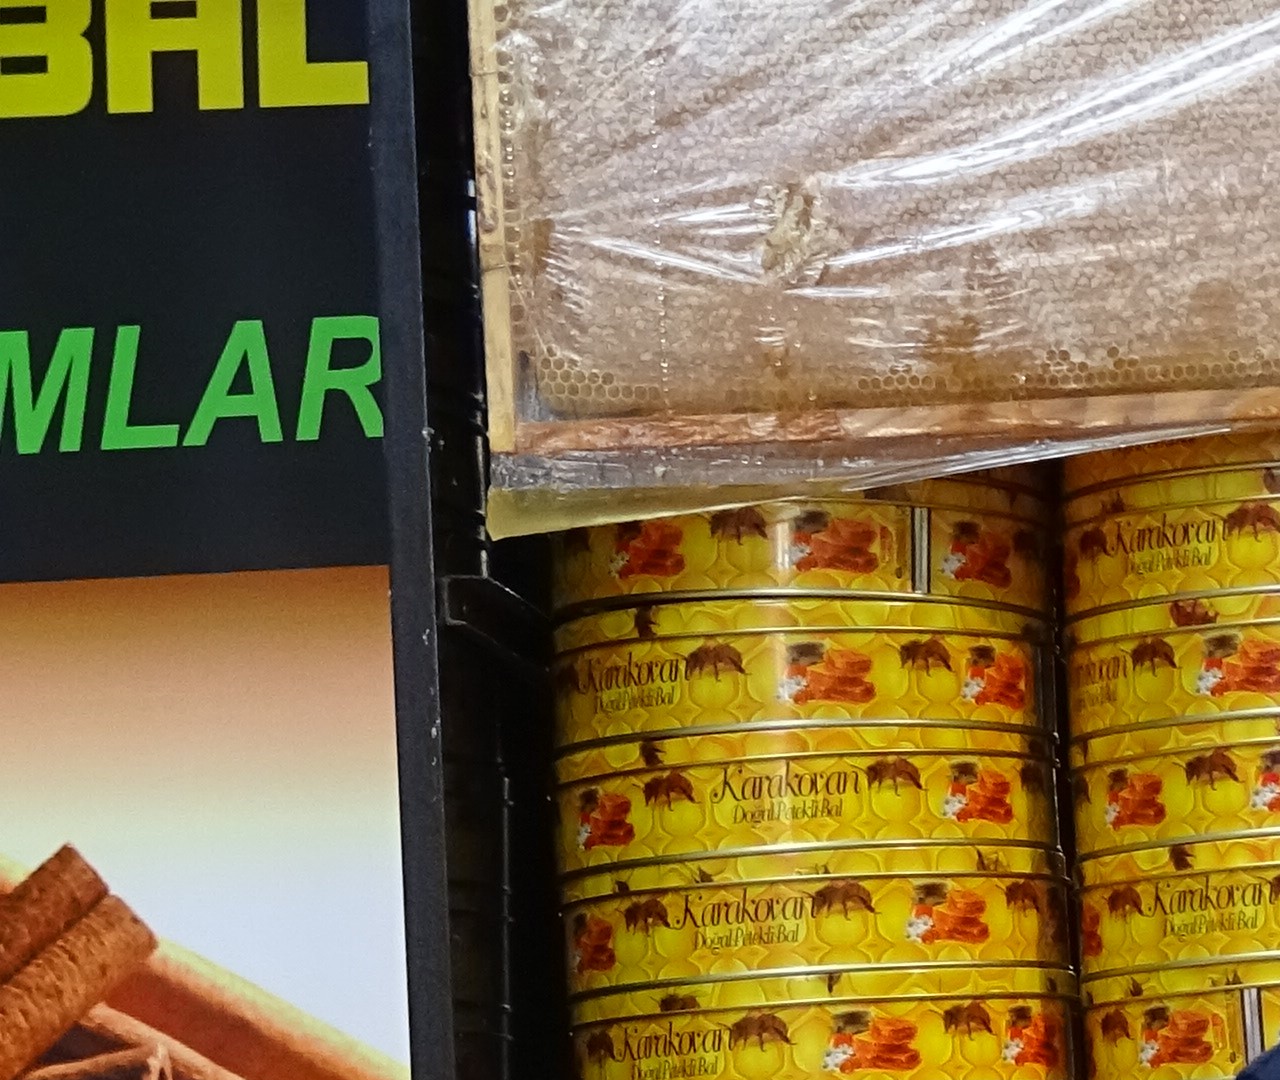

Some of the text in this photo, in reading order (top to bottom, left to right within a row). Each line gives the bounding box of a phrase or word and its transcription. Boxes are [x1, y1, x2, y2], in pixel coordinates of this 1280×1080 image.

[0, 0, 370, 118] BAL
[709, 760, 861, 804] Karakovan
[820, 798, 843, 818] Bal
[669, 887, 817, 930] Karakovan
[1140, 875, 1276, 918] Karakovan
[776, 923, 800, 943] Bal
[612, 1021, 734, 1063] Karakovan
